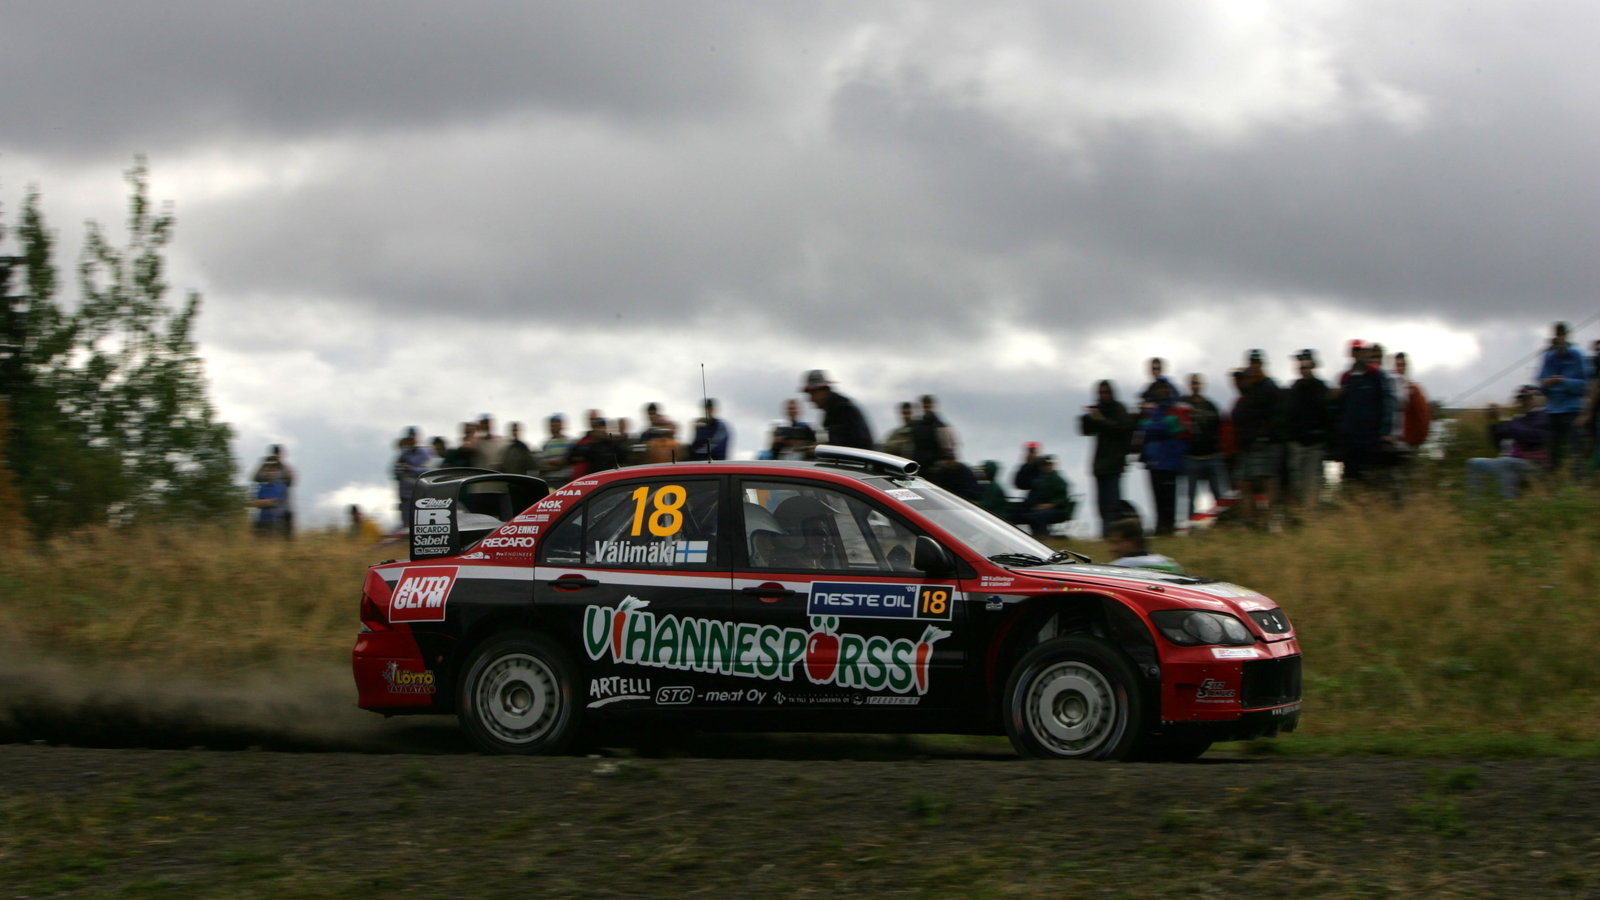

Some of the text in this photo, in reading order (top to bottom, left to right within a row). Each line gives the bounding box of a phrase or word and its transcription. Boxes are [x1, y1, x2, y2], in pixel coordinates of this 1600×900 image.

[538, 500, 563, 509] NGK
[631, 484, 687, 537] 18
[416, 526, 449, 534] RICARDO
[517, 526, 539, 534] ENKEI
[414, 535, 450, 546] Sabelt
[481, 537, 535, 548] RECARO
[594, 540, 676, 563] Välimäki
[398, 576, 451, 593] AUTO
[394, 591, 445, 610] GLYM
[814, 592, 911, 608] NESTE OIL
[921, 590, 947, 614] 18
[583, 598, 950, 696] VIHANNESPÖRSSI
[396, 670, 435, 685] LÖYTÖ
[589, 676, 651, 699] ARTELLI
[658, 687, 691, 702] STC
[746, 689, 767, 704] Oy
